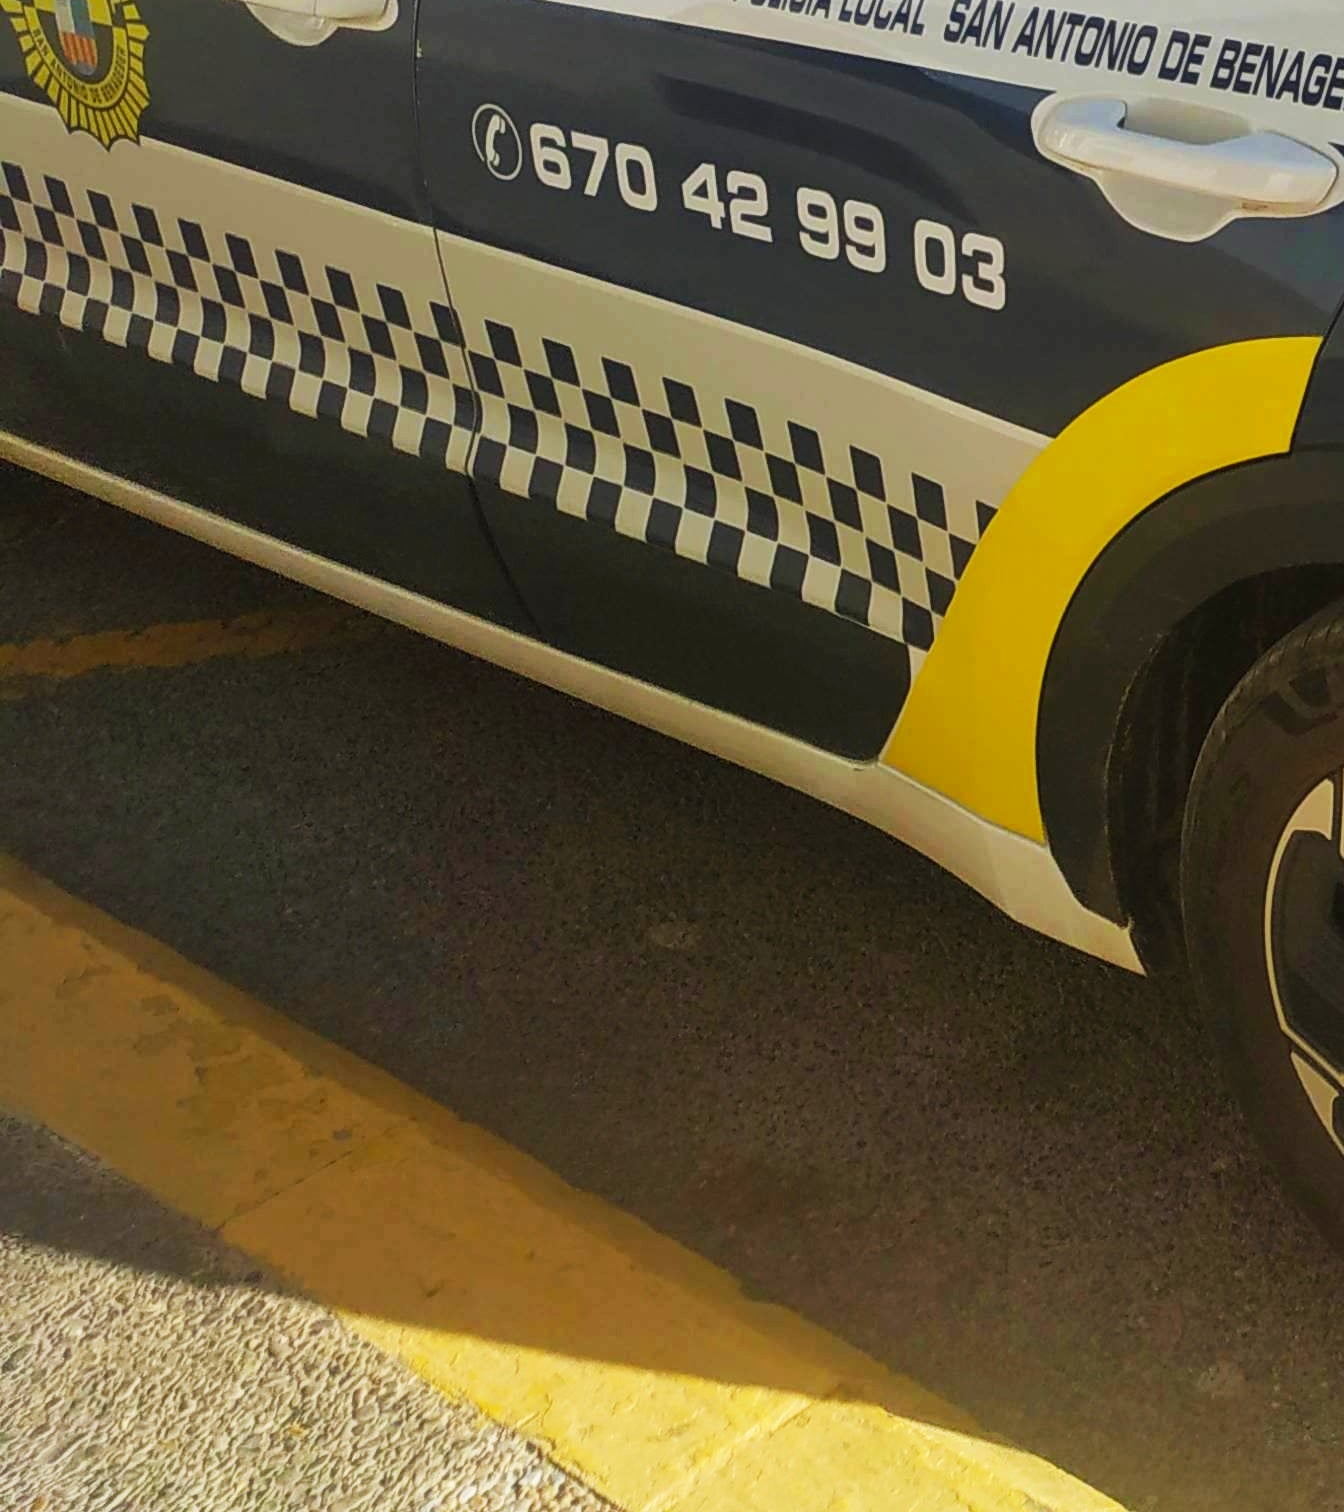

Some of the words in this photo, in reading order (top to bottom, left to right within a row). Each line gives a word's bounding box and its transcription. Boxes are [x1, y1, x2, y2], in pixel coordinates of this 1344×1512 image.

[1011, 5, 1158, 76] ANTONIO
[1157, 30, 1213, 85] DE
[529, 122, 658, 212] 670
[681, 162, 773, 243] 42
[796, 186, 887, 274] 99
[913, 218, 1006, 311] 03
